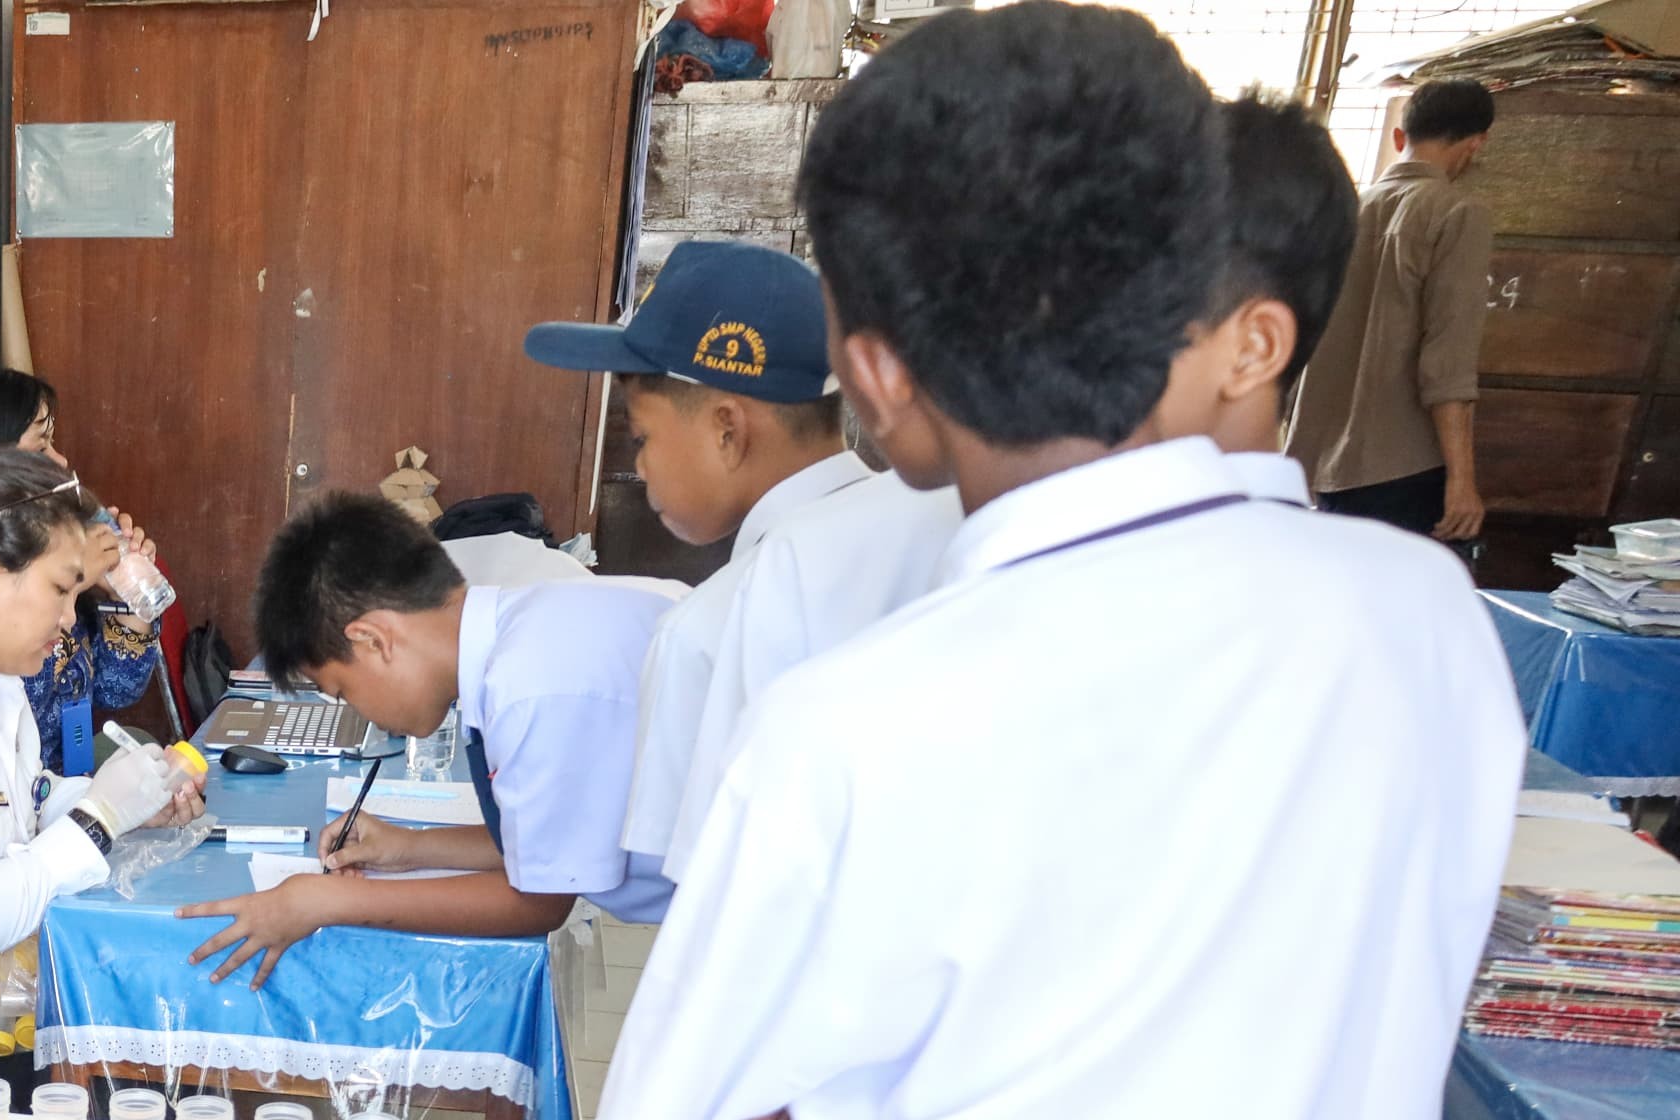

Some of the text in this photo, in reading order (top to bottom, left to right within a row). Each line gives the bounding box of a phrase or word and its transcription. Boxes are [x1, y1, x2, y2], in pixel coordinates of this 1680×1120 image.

[719, 321, 746, 336] SMP
[743, 326, 766, 364] NEGERI
[726, 338, 739, 359] 9
